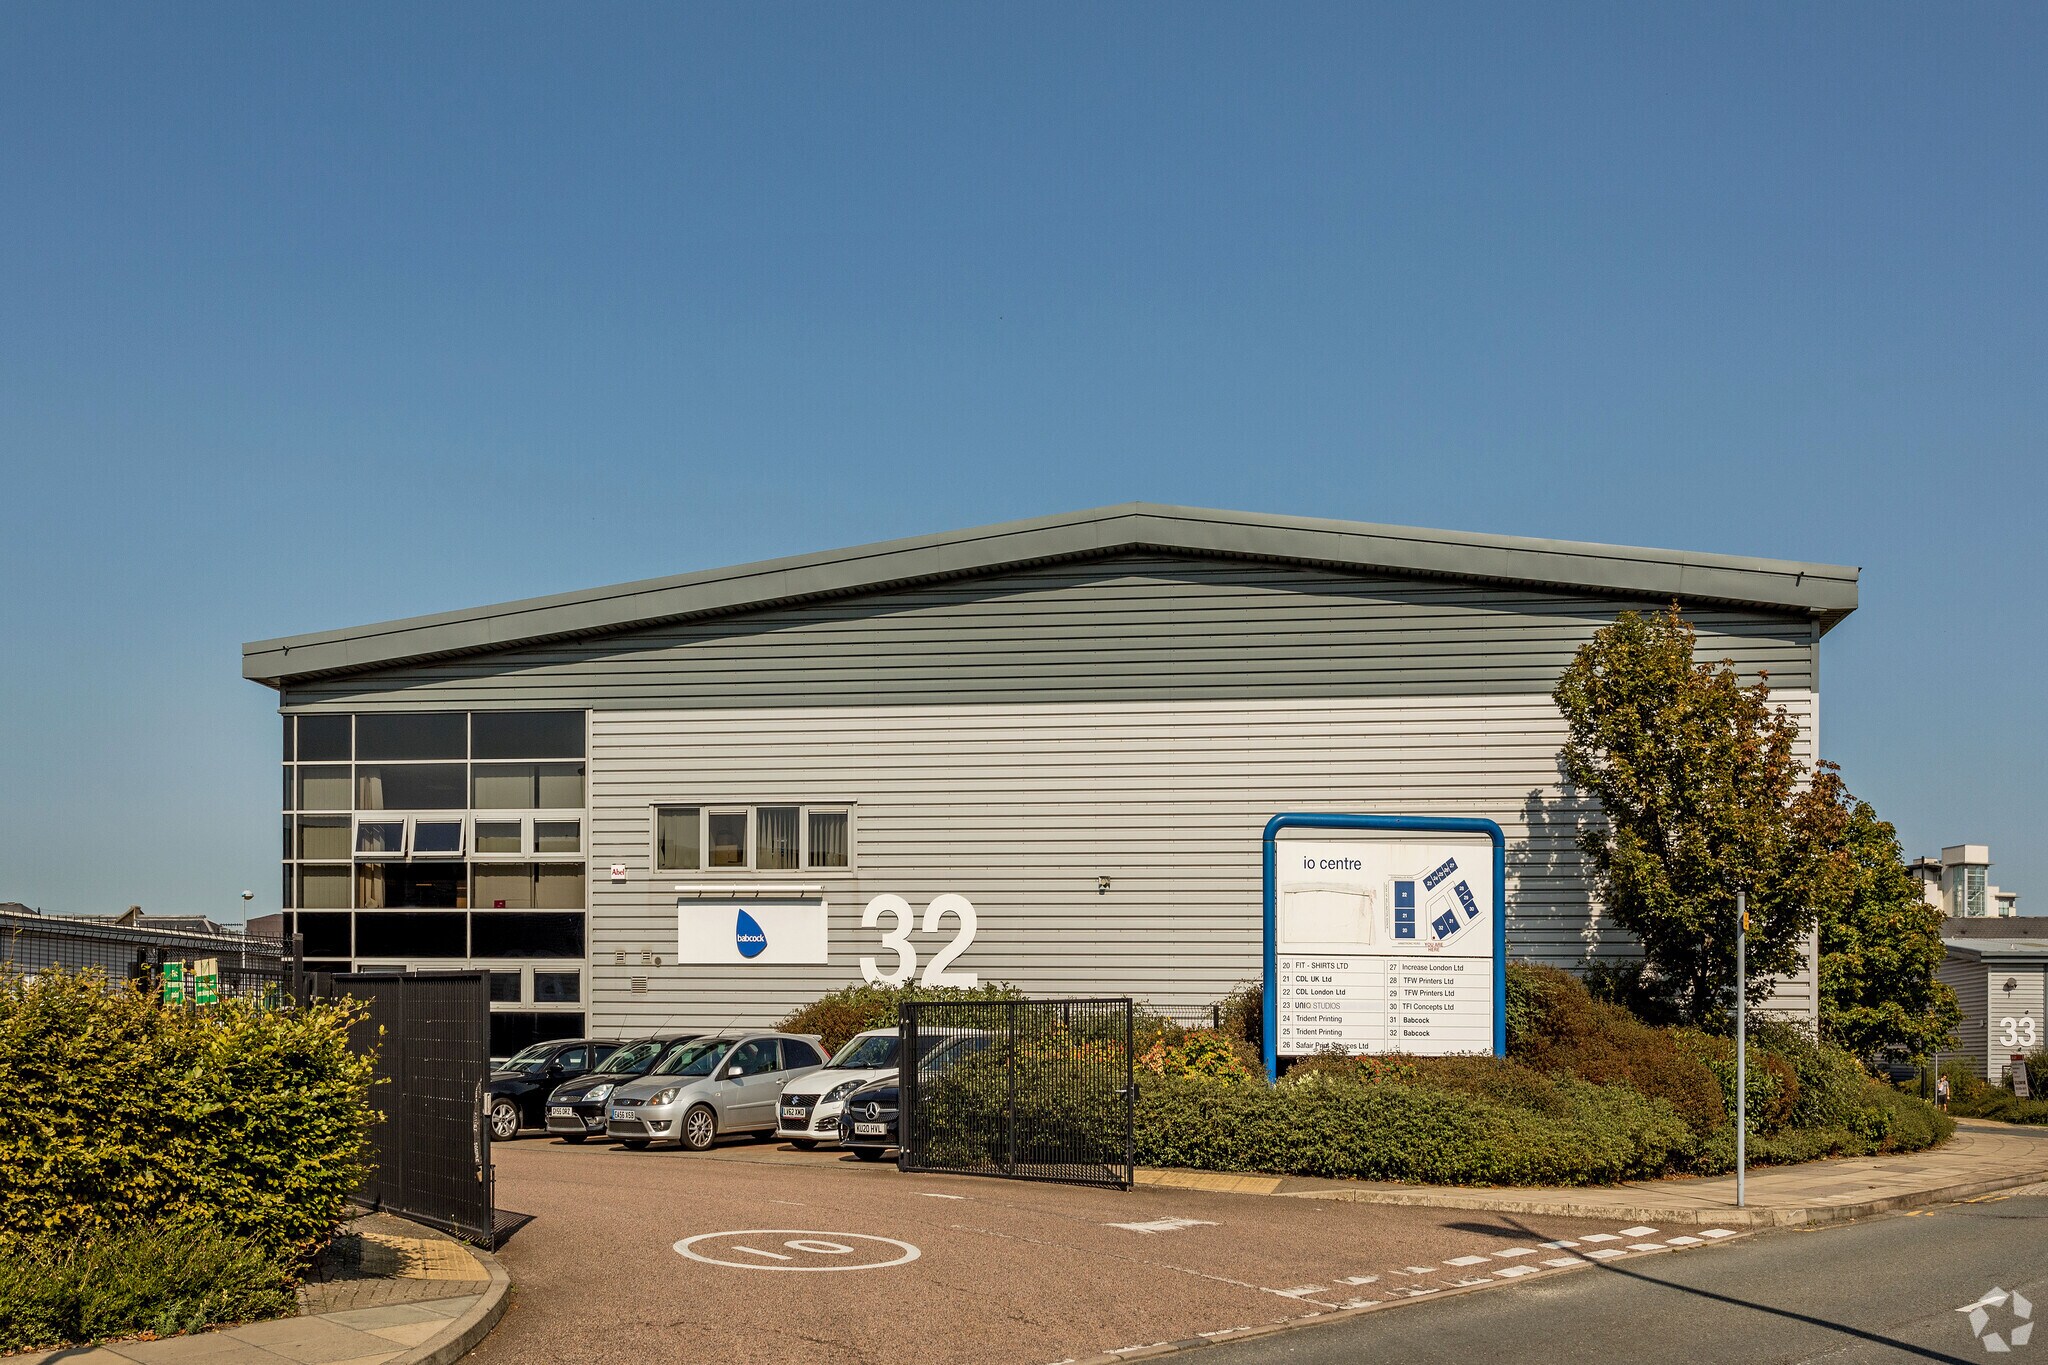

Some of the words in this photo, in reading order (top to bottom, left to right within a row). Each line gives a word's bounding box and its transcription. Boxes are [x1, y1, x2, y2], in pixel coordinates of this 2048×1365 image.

[1303, 855, 1316, 870] io
[1320, 857, 1362, 870] centre
[737, 934, 765, 942] babcock
[860, 894, 978, 991] 32
[1336, 962, 1349, 970] LTD
[1453, 964, 1464, 972] Ltd
[1413, 1003, 1443, 1011] Concepts
[1318, 1015, 1343, 1024] Printing
[1403, 1016, 1430, 1024] Babcock
[1318, 1028, 1343, 1037] Printing
[1403, 1029, 1430, 1037] Babcock
[2000, 1017, 2036, 1047] 33
[1296, 1041, 1314, 1049] Safair
